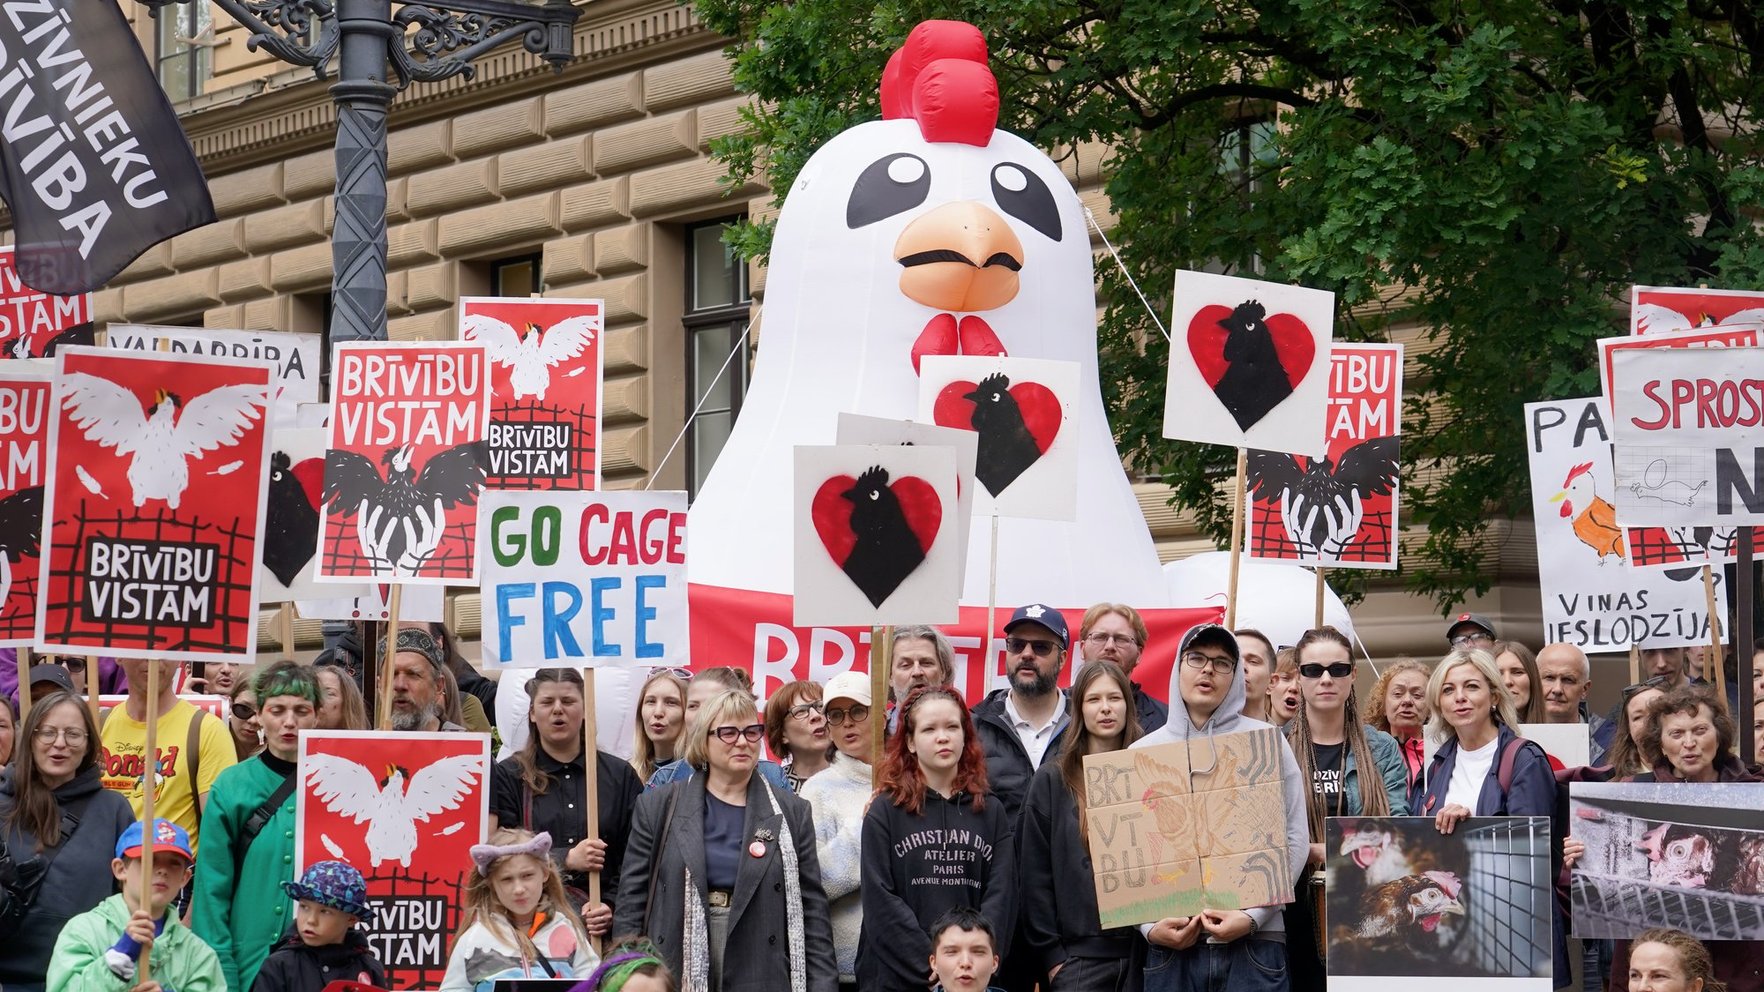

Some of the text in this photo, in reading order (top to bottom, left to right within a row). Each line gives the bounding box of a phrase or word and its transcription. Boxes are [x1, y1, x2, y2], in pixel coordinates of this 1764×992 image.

[0, 38, 112, 260] ĪVĪBA
[341, 353, 479, 398] BRĪVĪBU
[1328, 354, 1391, 394] ĪBU
[340, 401, 476, 446] VISTĀM
[489, 424, 569, 448] BRĪVĪBU
[1327, 398, 1387, 440] ĀM
[0, 440, 39, 491] M
[489, 450, 568, 475] VISTĀM
[490, 503, 687, 568] GO CAGE
[90, 542, 214, 583] BRĪVĪBU
[89, 580, 210, 623] VISTĀM
[495, 575, 667, 662] FREE
[1558, 589, 1649, 616] VIŅAS
[1549, 608, 1724, 646] IESLODZĪJA
[894, 828, 970, 858] CHRISTIAN
[924, 849, 975, 862] ATELIER
[911, 877, 940, 886] AVENUE
[933, 865, 964, 874] PARIS
